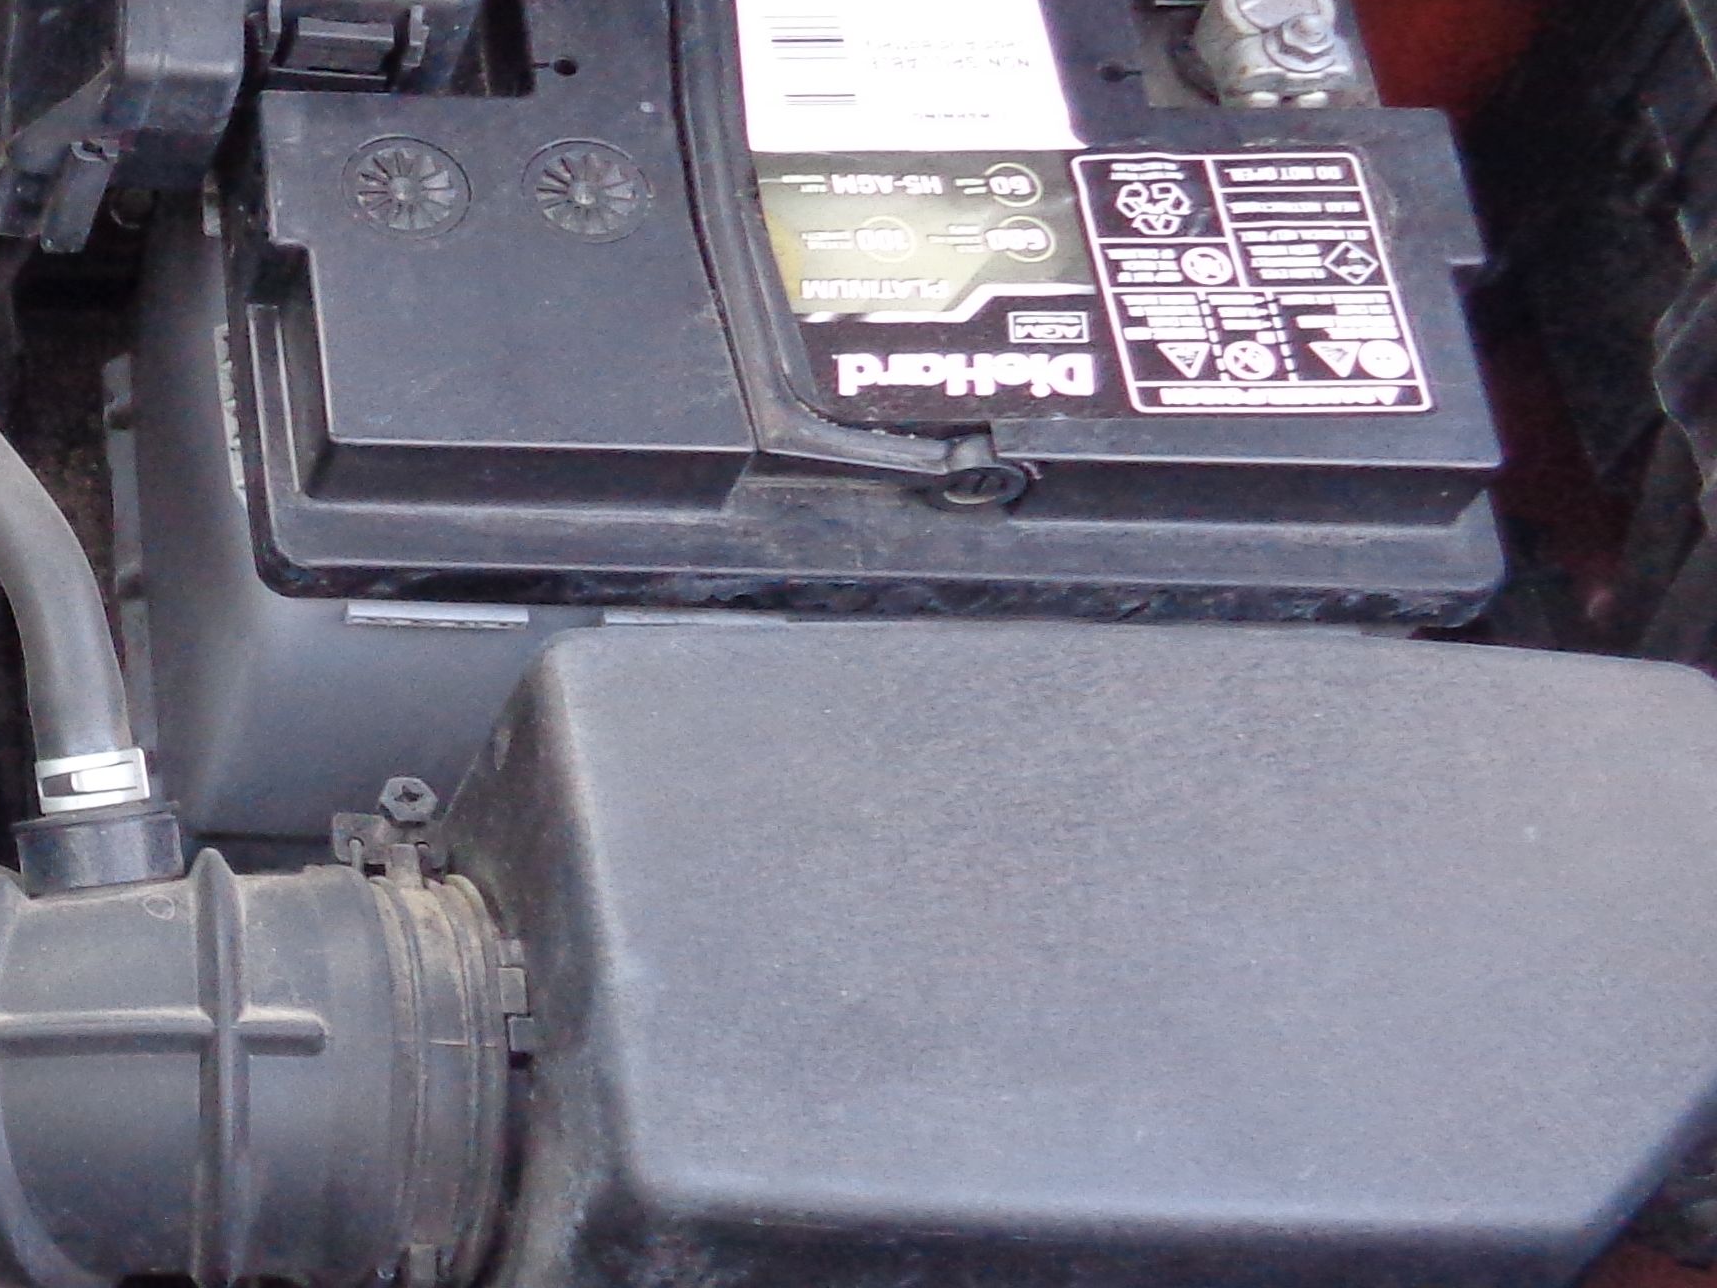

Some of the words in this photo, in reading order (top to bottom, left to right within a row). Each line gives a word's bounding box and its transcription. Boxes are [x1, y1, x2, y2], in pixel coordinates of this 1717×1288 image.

[1279, 166, 1315, 180] NOT
[1316, 165, 1344, 180] DO
[988, 175, 1031, 195] 60
[854, 228, 910, 251] 100
[801, 279, 949, 299] PLATINUM
[1015, 324, 1082, 339] AGM
[837, 353, 1094, 397] DieHard
